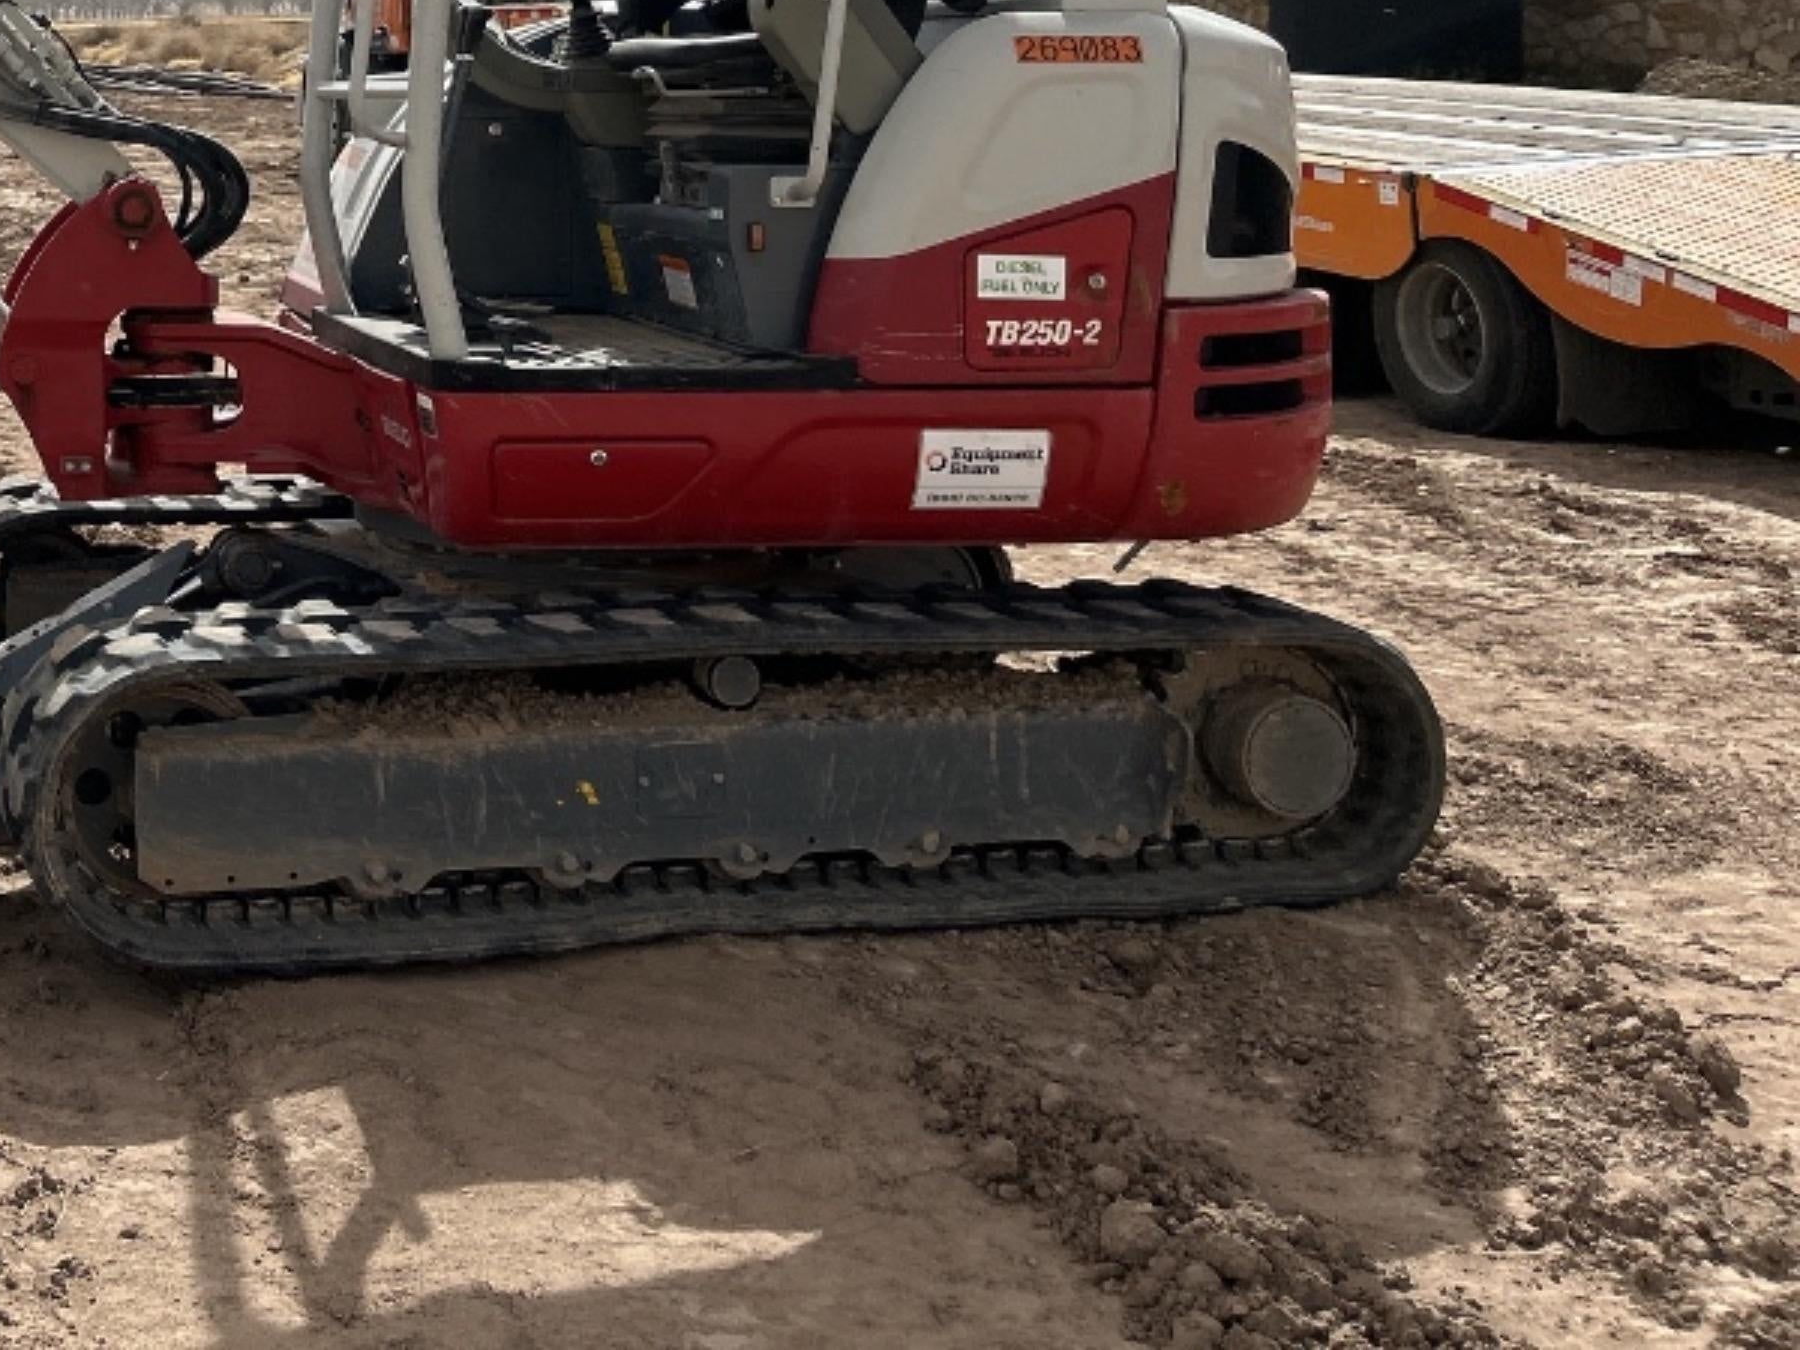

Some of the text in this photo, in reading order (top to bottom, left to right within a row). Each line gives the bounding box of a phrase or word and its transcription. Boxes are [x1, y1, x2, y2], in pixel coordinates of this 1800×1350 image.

[1015, 35, 1143, 63] 269083
[985, 319, 1103, 346] TB250-2
[950, 446, 1044, 462] Equipment
[950, 461, 1001, 475] Share
